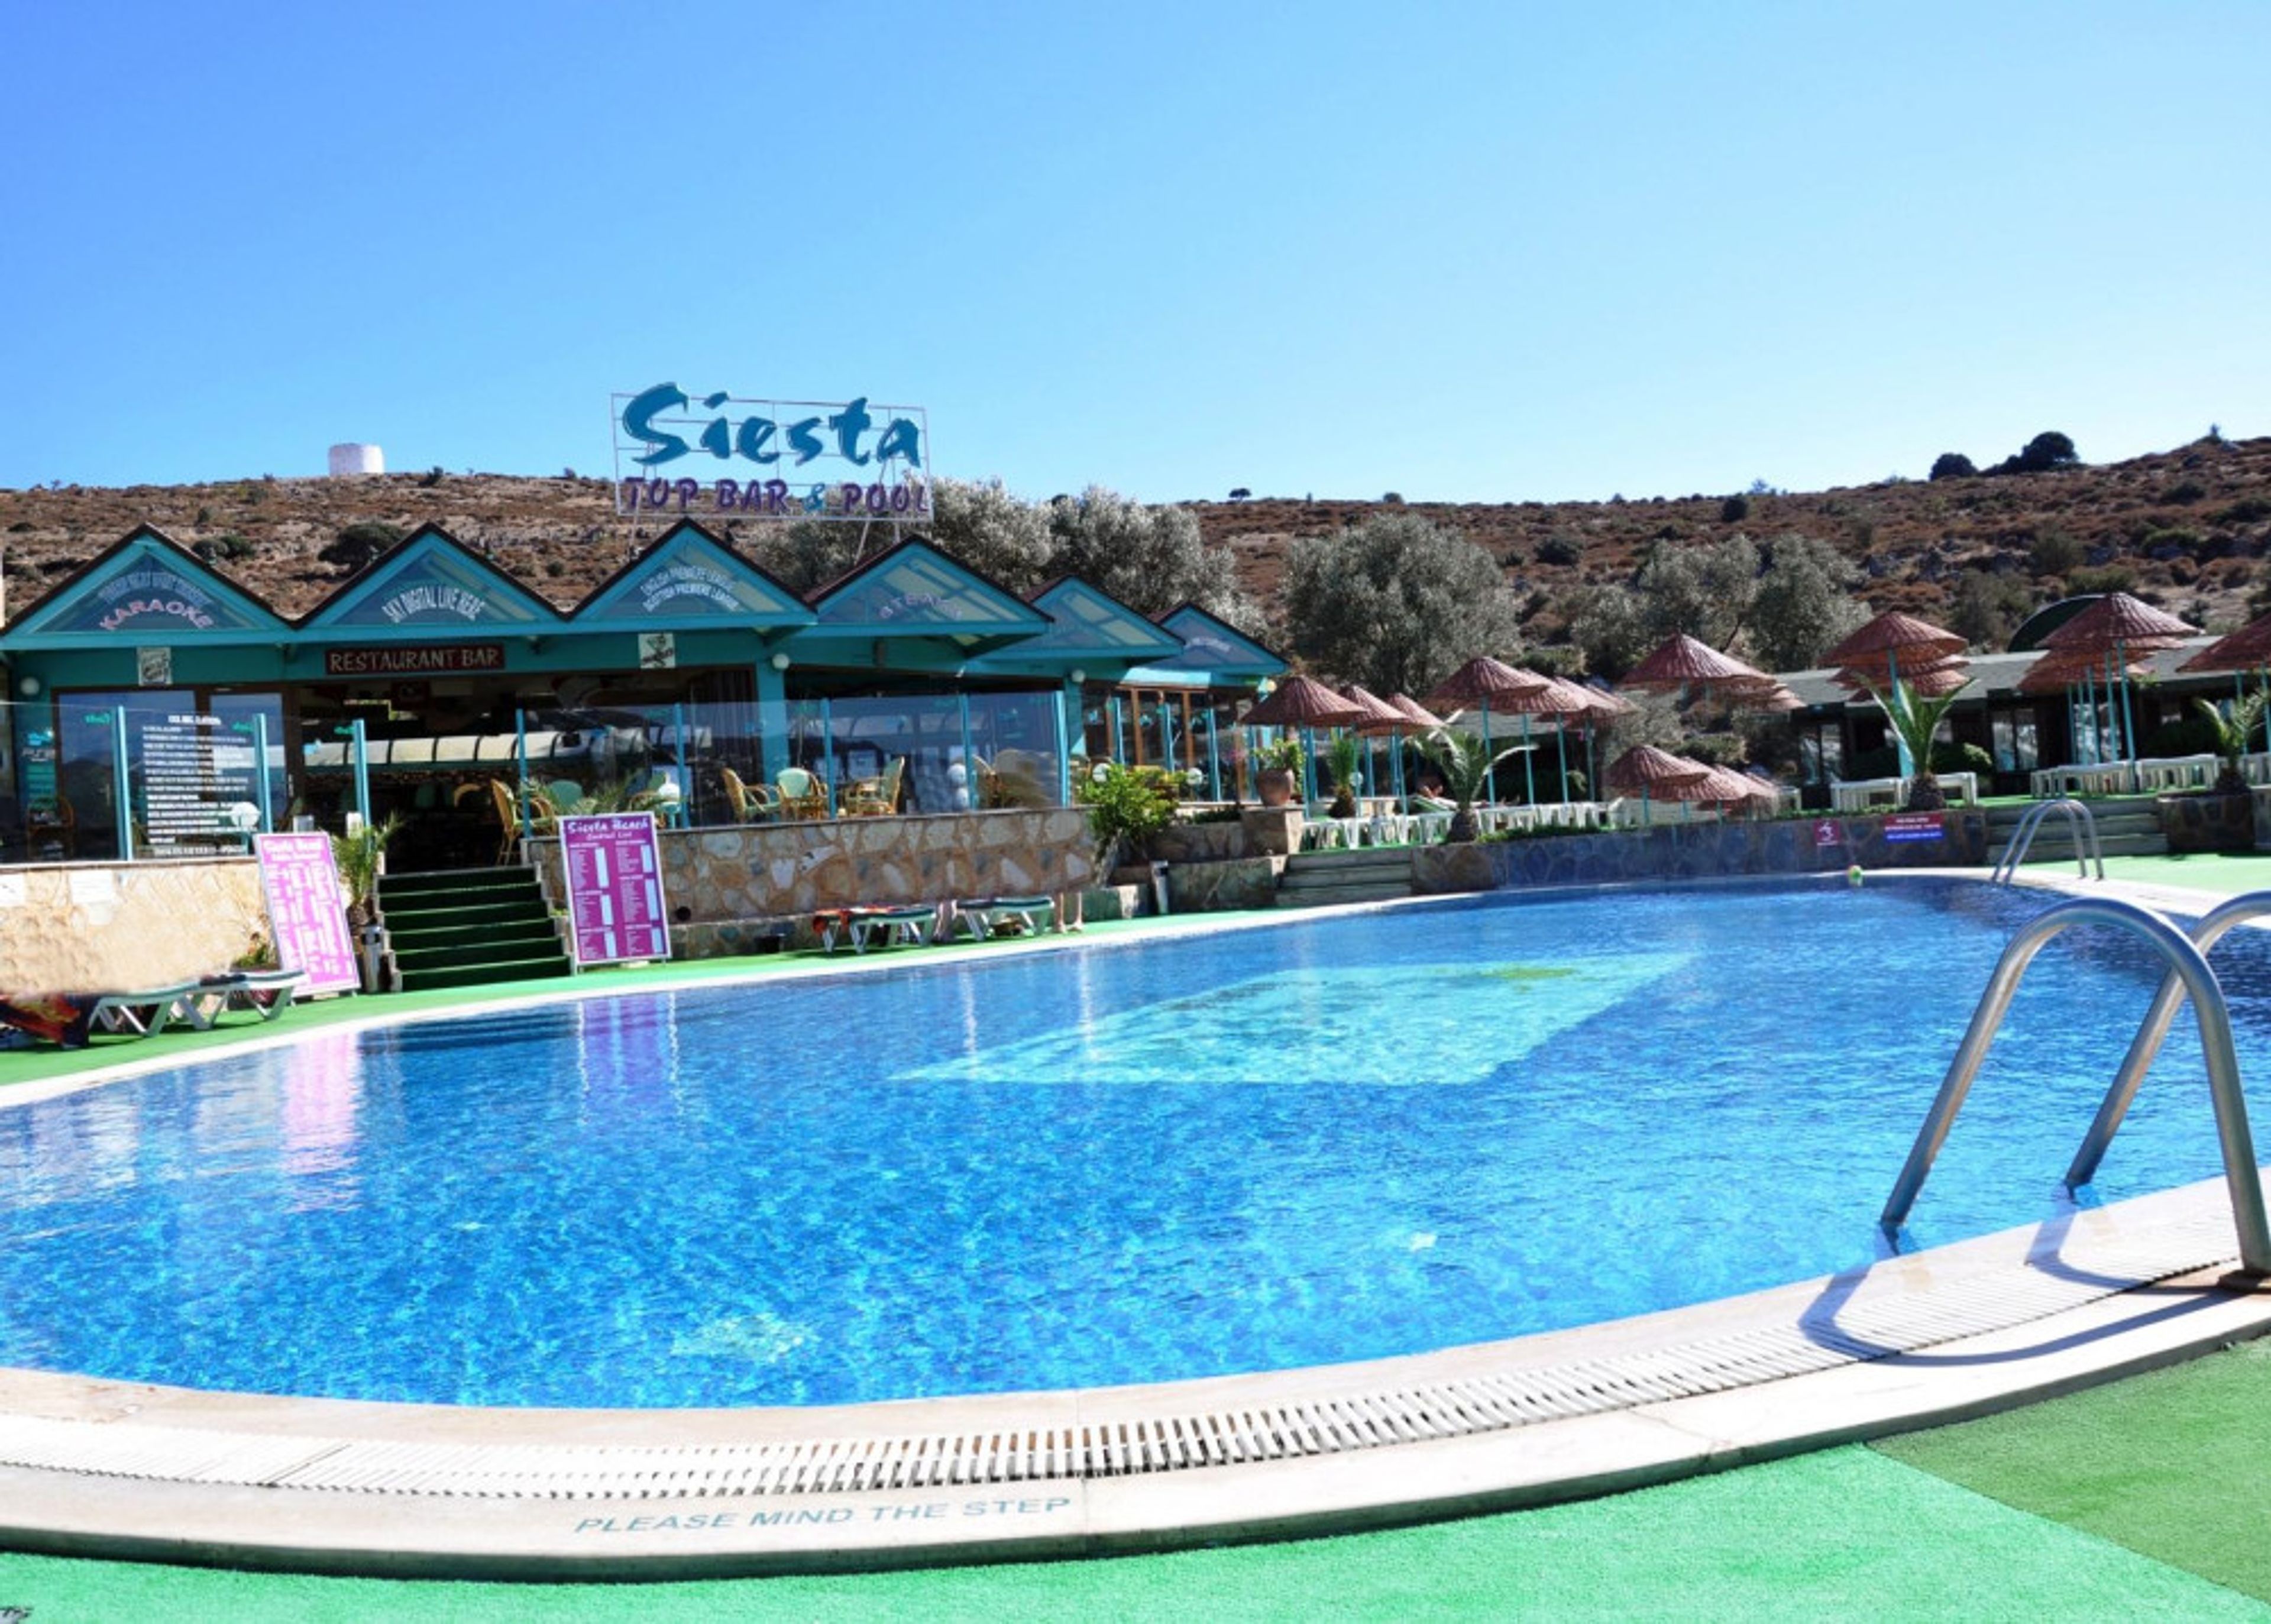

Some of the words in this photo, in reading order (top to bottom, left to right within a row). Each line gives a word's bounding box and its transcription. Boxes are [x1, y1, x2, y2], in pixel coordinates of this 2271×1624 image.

[622, 381, 920, 467] Siesta
[625, 477, 698, 509] TOP
[716, 478, 790, 513] BAR
[803, 483, 826, 512] &
[841, 483, 929, 513] POOL
[99, 599, 213, 630] KARAOKE
[330, 651, 454, 672] RESTAURANT
[462, 648, 499, 667] BAR
[574, 1512, 738, 1533] PLEASE
[749, 1507, 853, 1527] MIND
[873, 1503, 949, 1521] THE
[962, 1497, 1071, 1516] STEP
